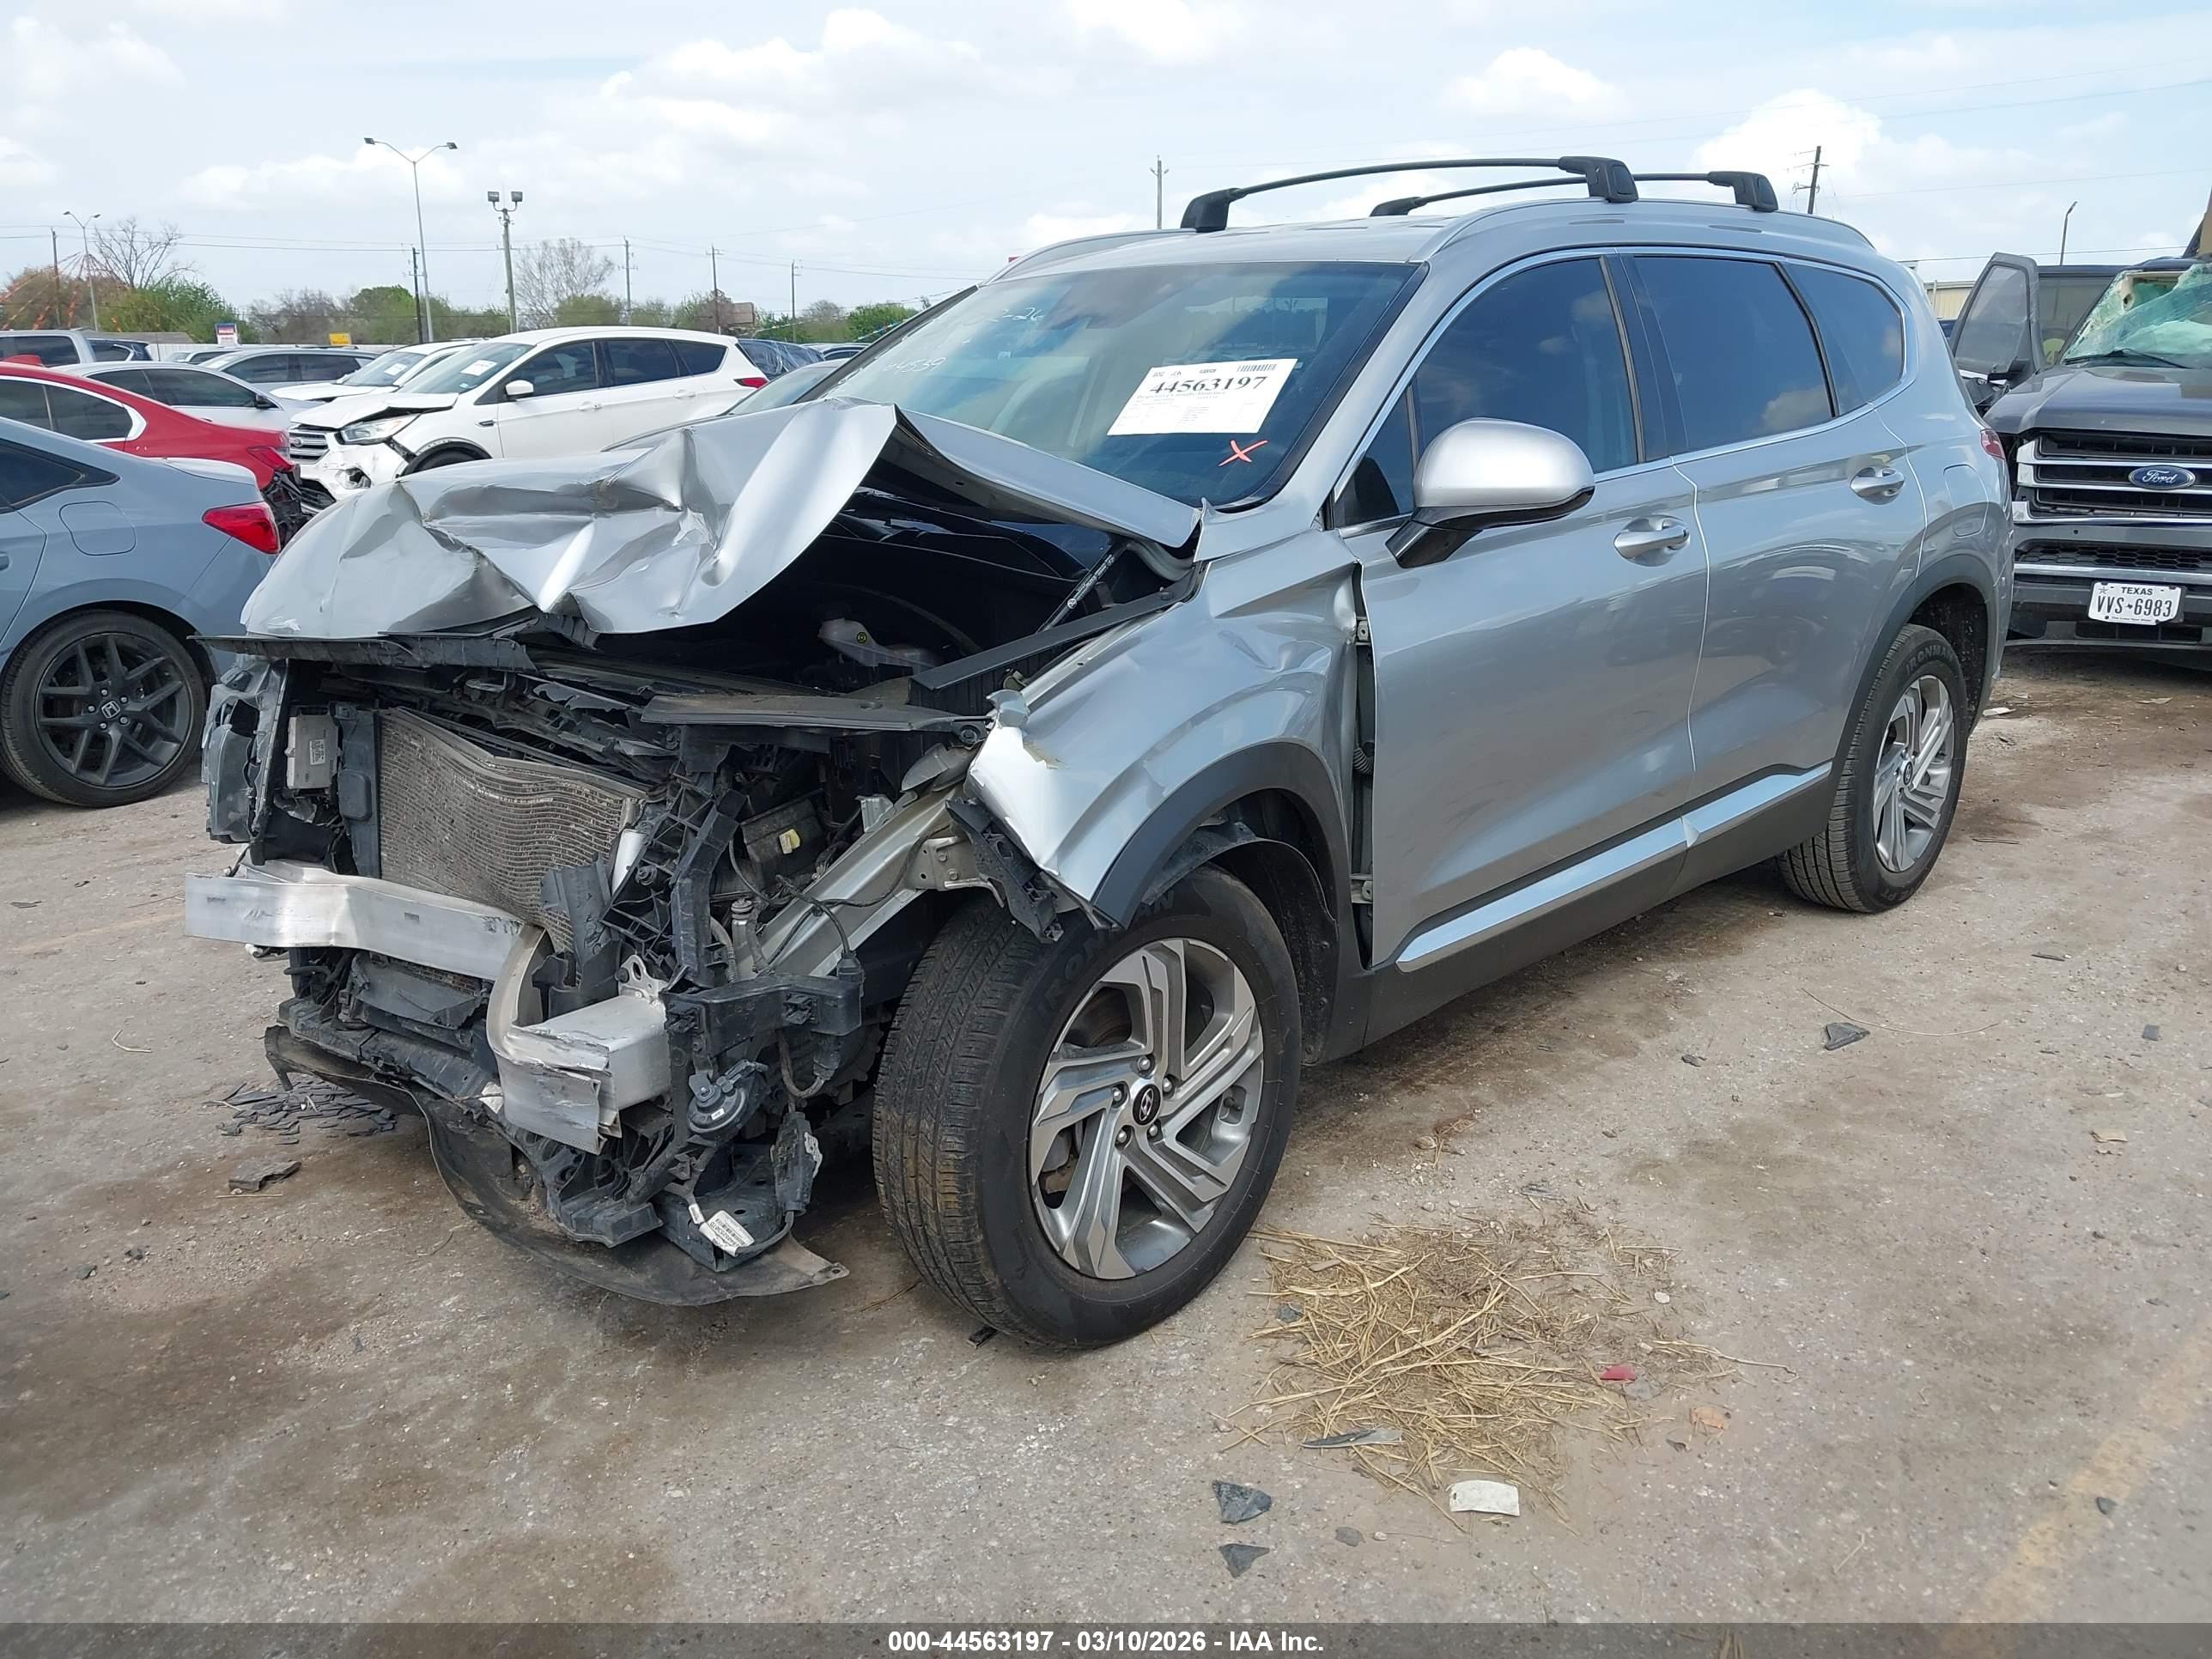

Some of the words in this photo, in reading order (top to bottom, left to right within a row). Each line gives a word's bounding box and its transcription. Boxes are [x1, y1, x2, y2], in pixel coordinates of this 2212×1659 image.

[1148, 375, 1268, 394] 44563197
[2142, 469, 2179, 483] Ford
[2121, 586, 2154, 596] TEXAS
